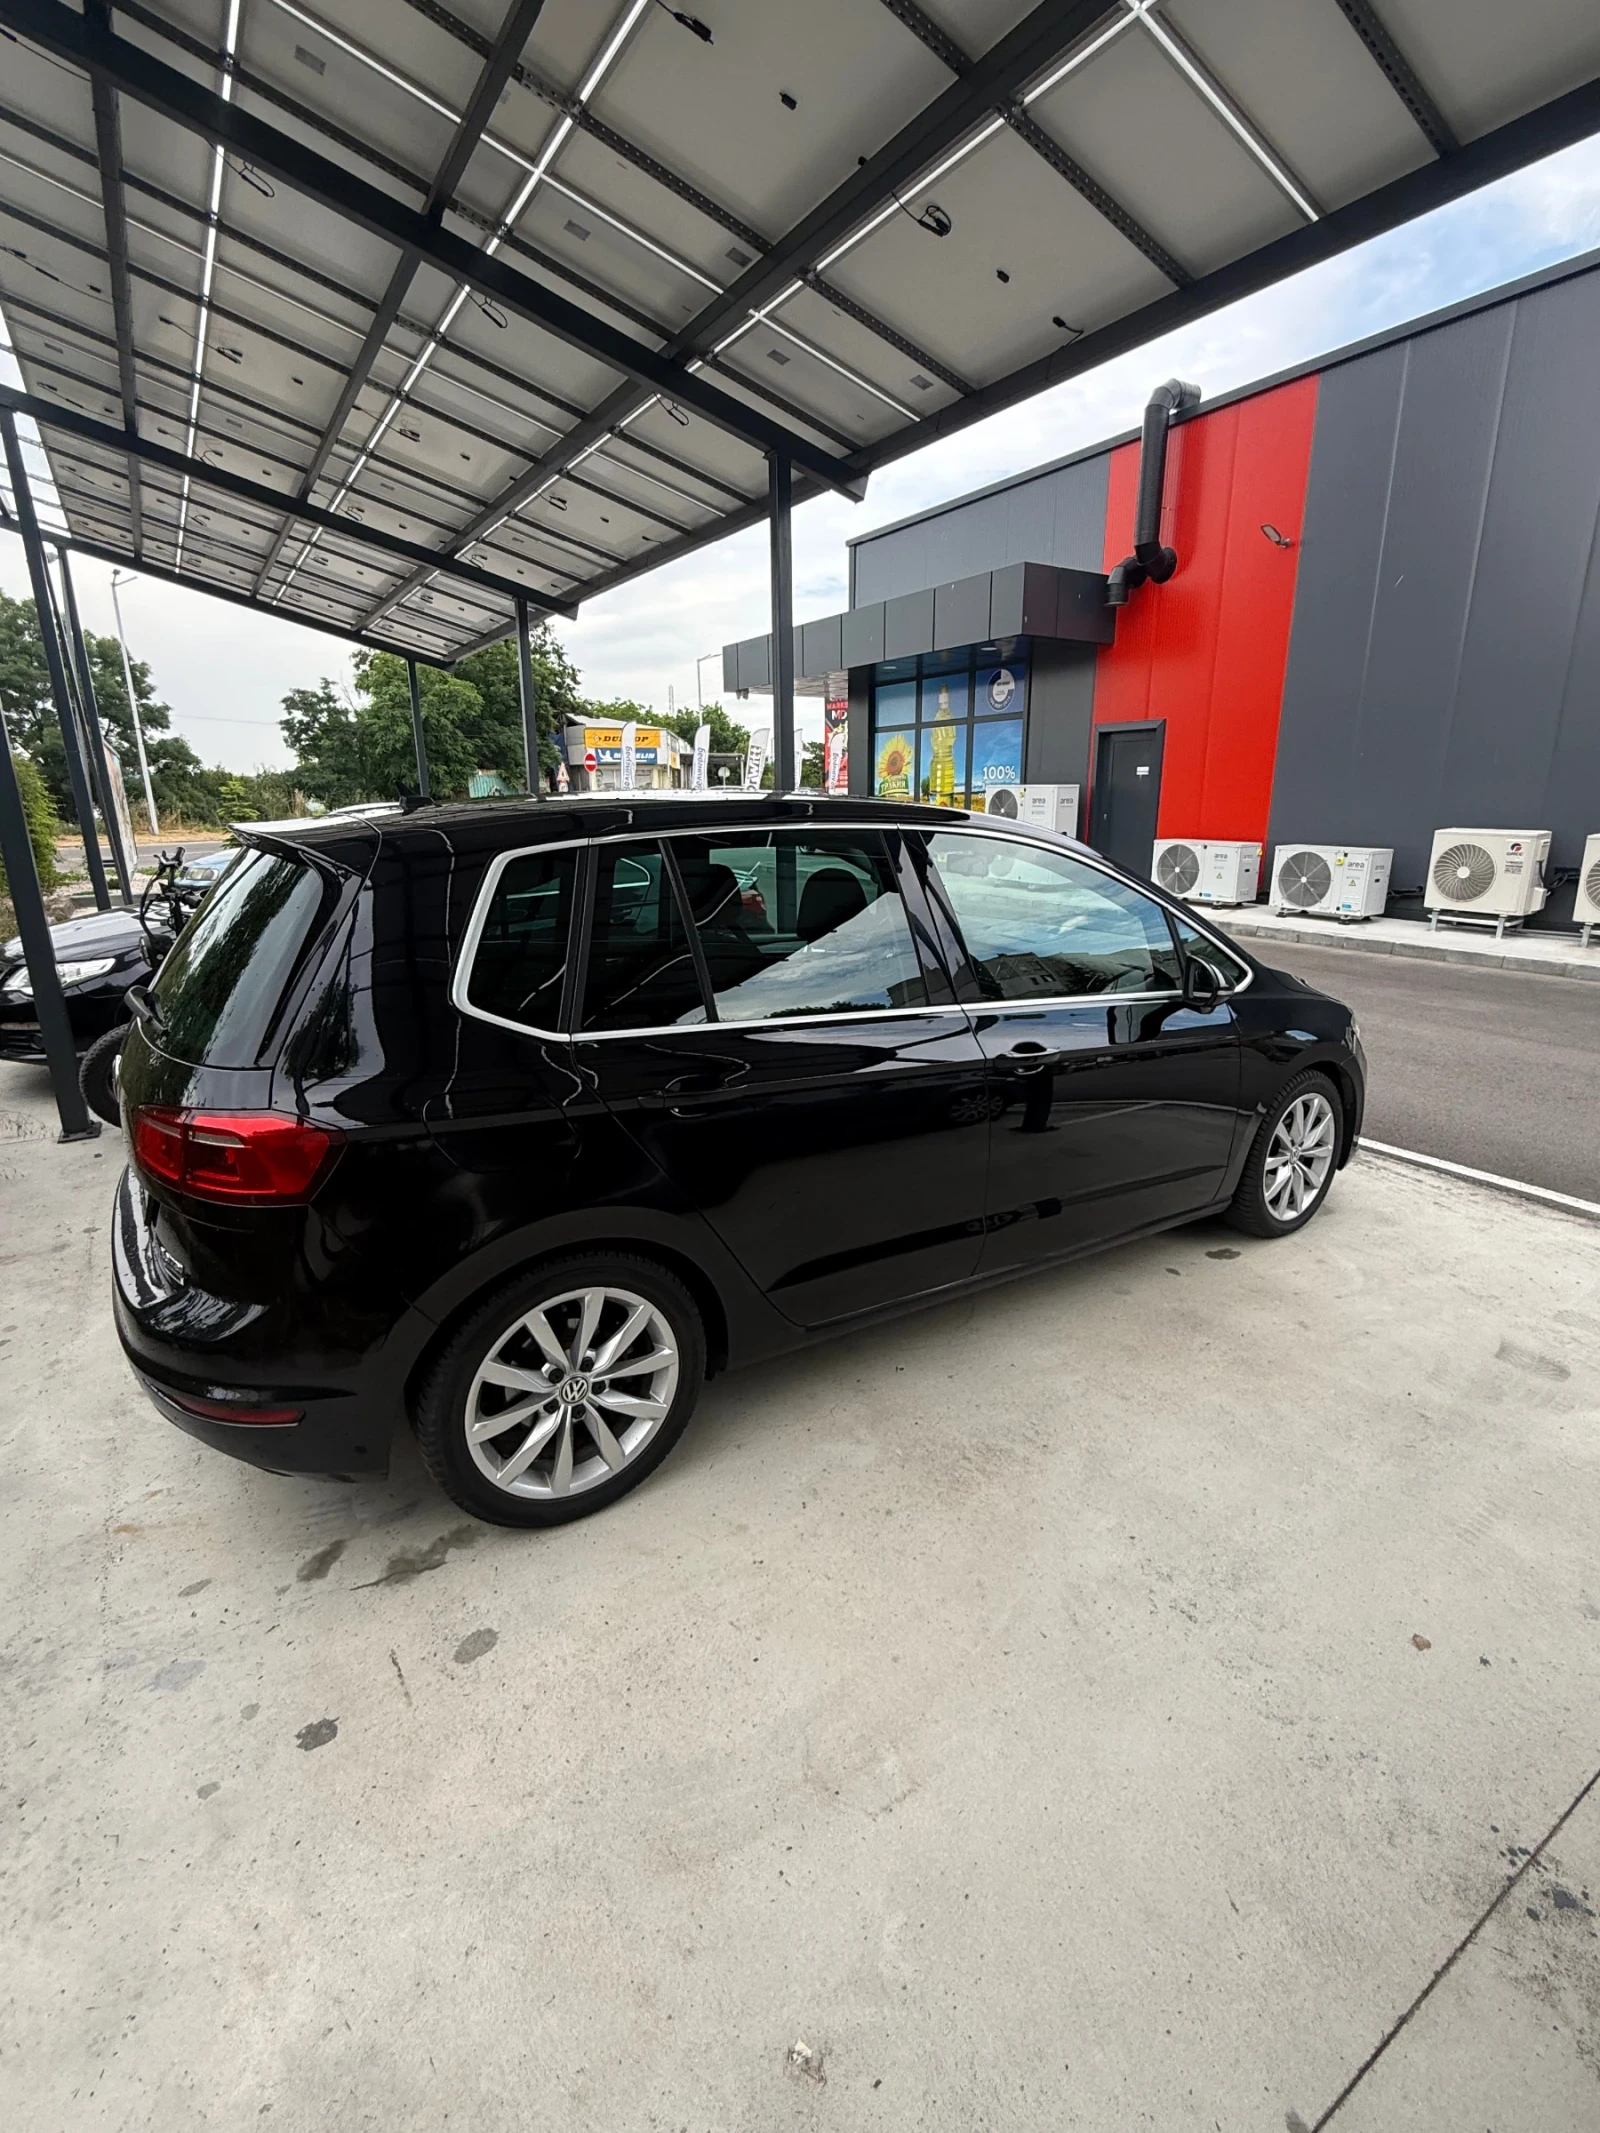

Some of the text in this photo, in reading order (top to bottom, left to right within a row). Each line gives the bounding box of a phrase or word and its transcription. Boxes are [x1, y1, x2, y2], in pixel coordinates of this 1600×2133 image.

[826, 701, 848, 710] MARKE
[831, 709, 848, 720] MD
[983, 765, 1015, 779] 100%
[562, 1377, 588, 1402] VW
